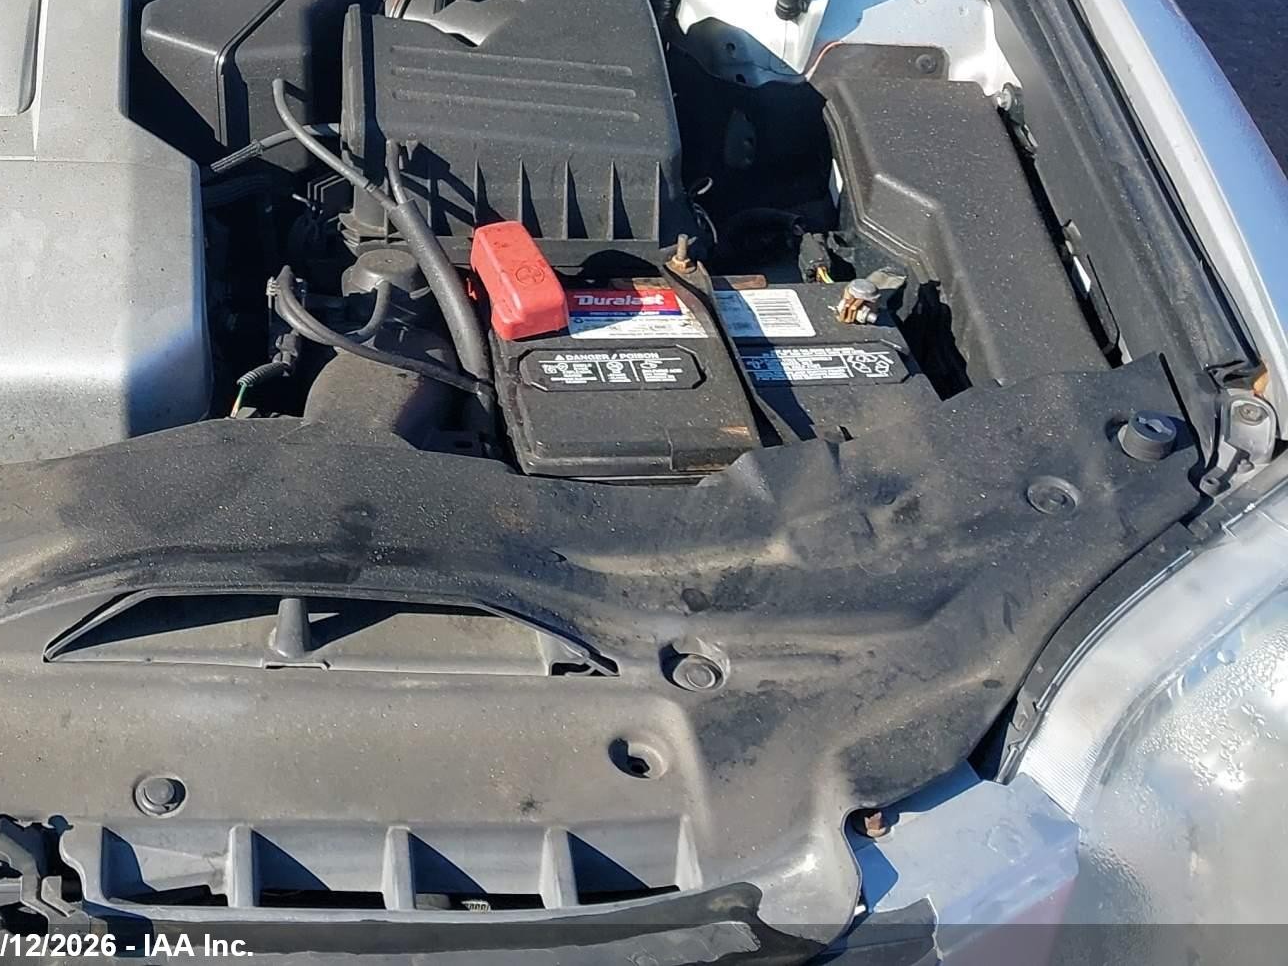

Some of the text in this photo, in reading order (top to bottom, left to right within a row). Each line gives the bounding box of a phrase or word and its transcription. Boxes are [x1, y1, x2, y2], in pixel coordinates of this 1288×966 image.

[573, 294, 664, 306] Duralast
[565, 353, 610, 361] DANGER
[619, 352, 659, 360] POISON
